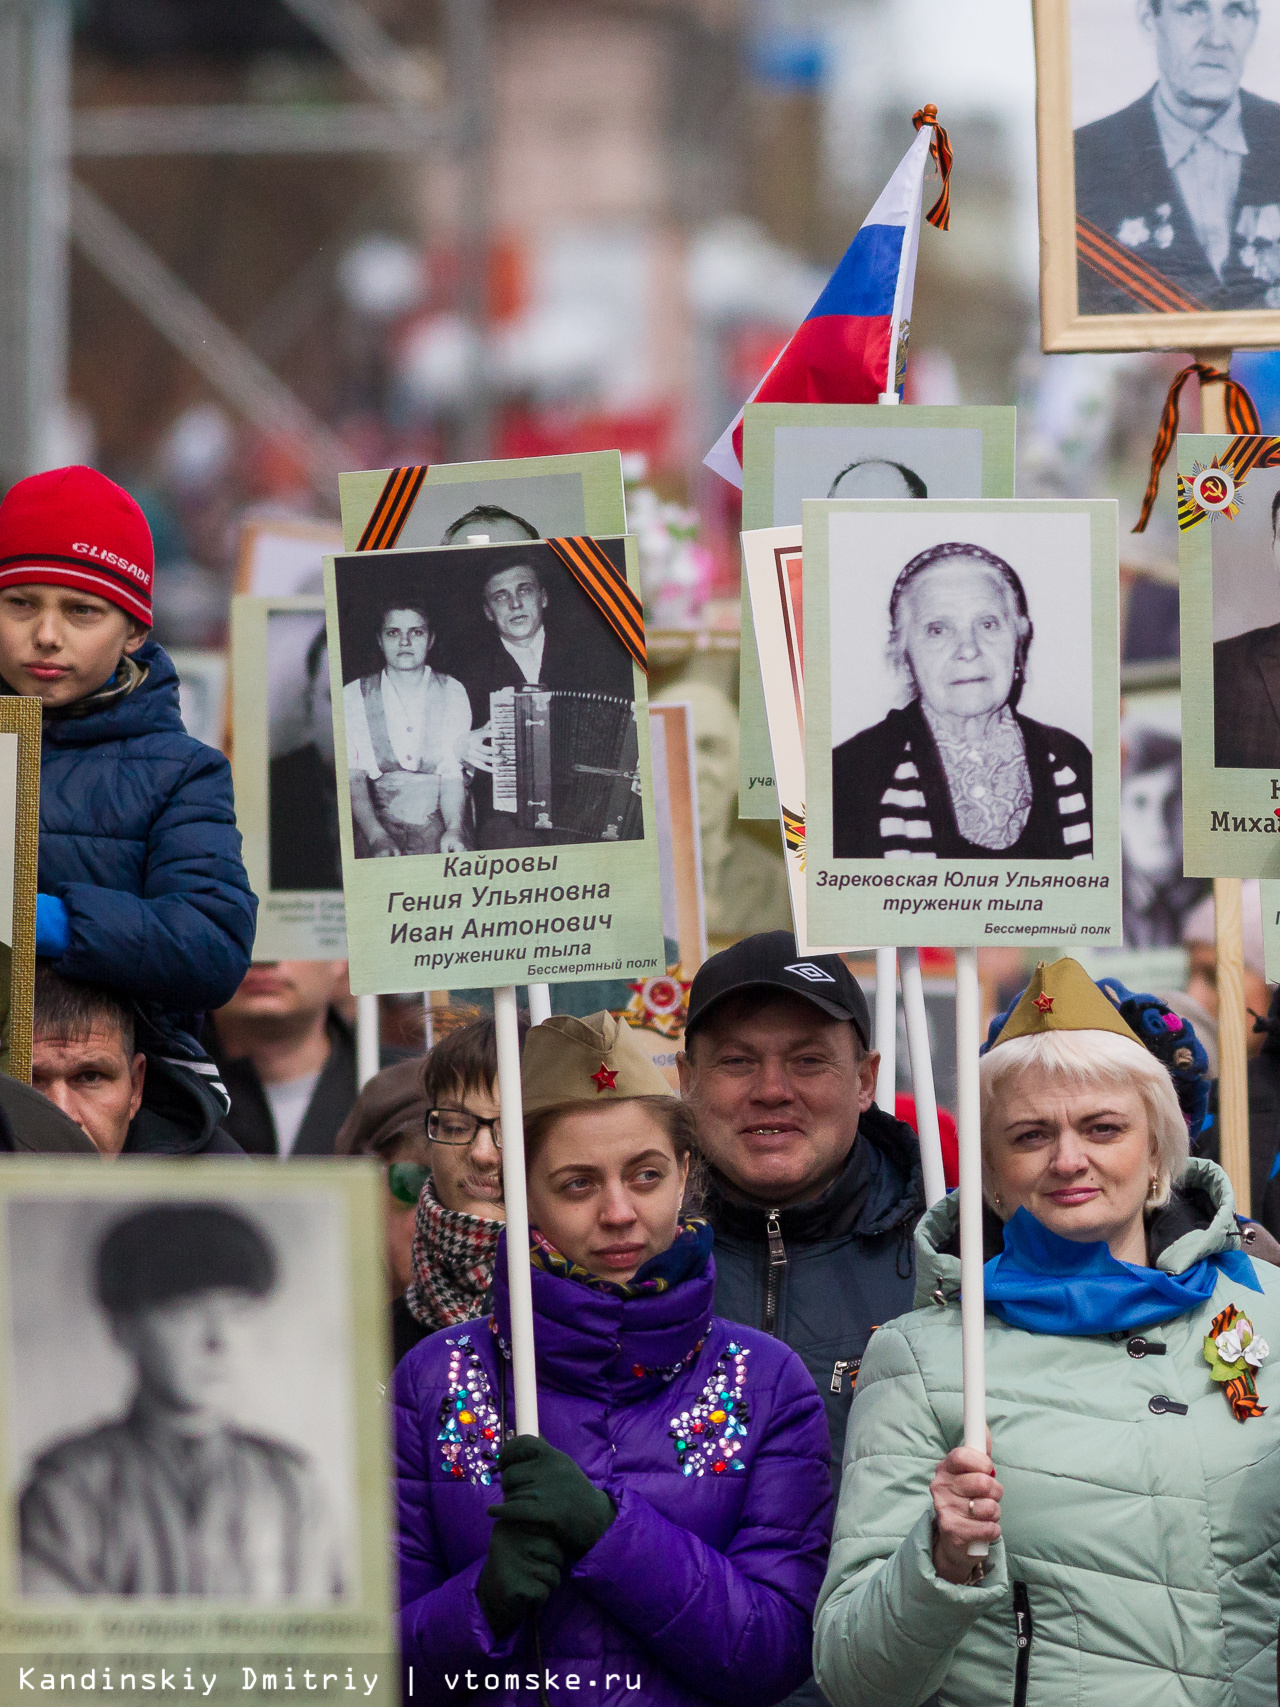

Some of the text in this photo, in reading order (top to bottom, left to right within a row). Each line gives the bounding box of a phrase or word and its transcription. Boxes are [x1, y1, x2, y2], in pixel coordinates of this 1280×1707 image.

[72, 542, 151, 585] GLISSADE
[443, 855, 558, 880] Кайровы
[816, 870, 1110, 890] Зарековская Юлия Ульяновна
[387, 882, 611, 913] Гения Ульяновна
[883, 898, 1044, 914] труженик тыла
[390, 913, 613, 944] Иван Антонович
[984, 922, 1111, 936] Бессмертный полк
[414, 943, 592, 970] труженики тыла
[527, 958, 658, 976] Бессмертный полк
